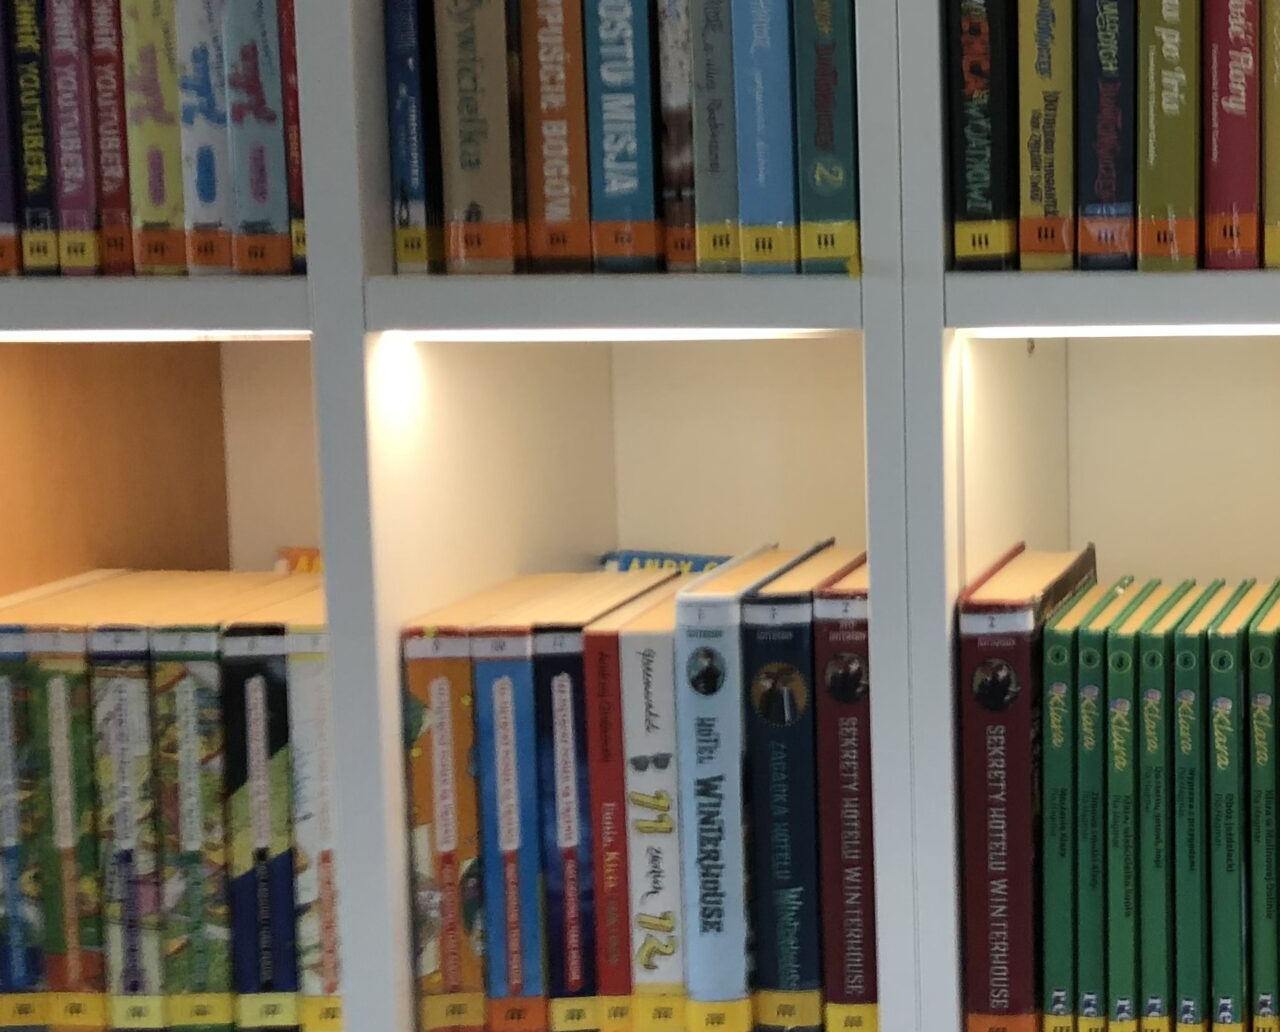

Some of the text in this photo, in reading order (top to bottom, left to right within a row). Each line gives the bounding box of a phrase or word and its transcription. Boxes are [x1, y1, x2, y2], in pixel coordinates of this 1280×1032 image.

[1155, 25, 1180, 64] po
[543, 119, 576, 221] BOGÓW
[602, 92, 640, 192] MISJA
[815, 163, 844, 185] 2
[1213, 708, 1232, 770] Klara
[1252, 704, 1273, 767] Klara
[694, 774, 726, 935] WINTERHOUSE
[838, 717, 865, 995] SEKRETY HOTELU WINTERHOUSE
[986, 725, 1010, 1009] SEKRETY HOTELU WINTERHOUSE
[634, 910, 675, 969] 12
